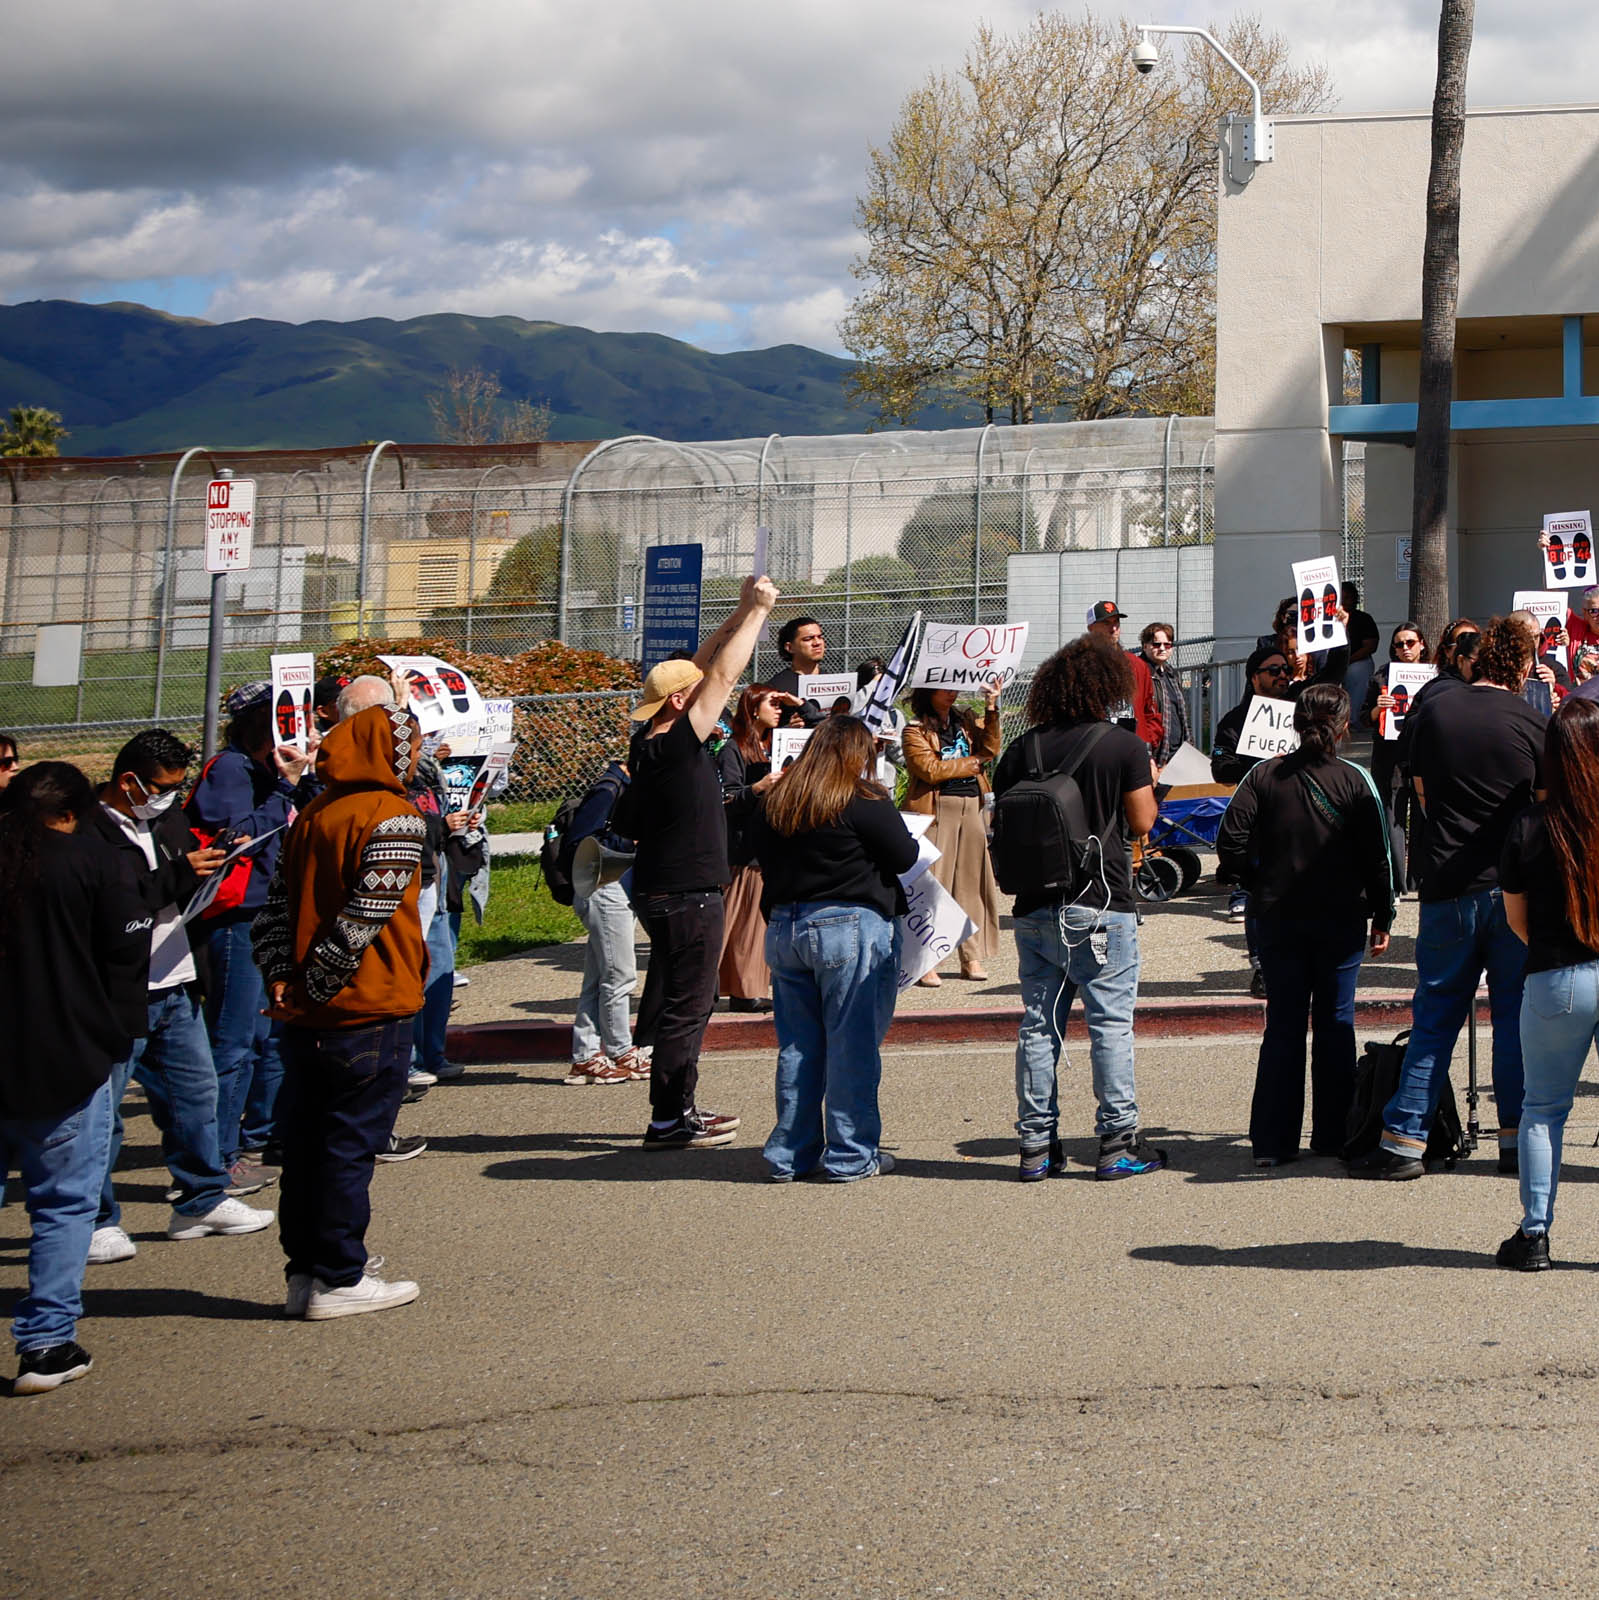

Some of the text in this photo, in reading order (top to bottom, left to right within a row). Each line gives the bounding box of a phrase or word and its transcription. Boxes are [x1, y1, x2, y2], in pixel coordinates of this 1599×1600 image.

[211, 485, 227, 505] NO
[210, 512, 250, 529] STOPPING
[1552, 522, 1583, 531] MISSING
[221, 532, 239, 544] ANY
[219, 548, 239, 560] TIME
[1547, 548, 1591, 563] 18 OF 46
[1304, 571, 1330, 582] MISSING
[1311, 602, 1336, 620] OF 46
[1526, 603, 1558, 614] MISSING
[962, 627, 1024, 659] OUT
[976, 659, 998, 668] OF
[282, 671, 308, 681] MISSING
[925, 667, 1014, 684] ELMWOOD
[424, 682, 442, 697] OF
[448, 676, 467, 692] 46
[810, 685, 848, 694] MISSING
[289, 717, 302, 734] OF
[479, 724, 510, 735] MELTING
[789, 740, 806, 749] MISS
[1248, 735, 1296, 753] FUERA
